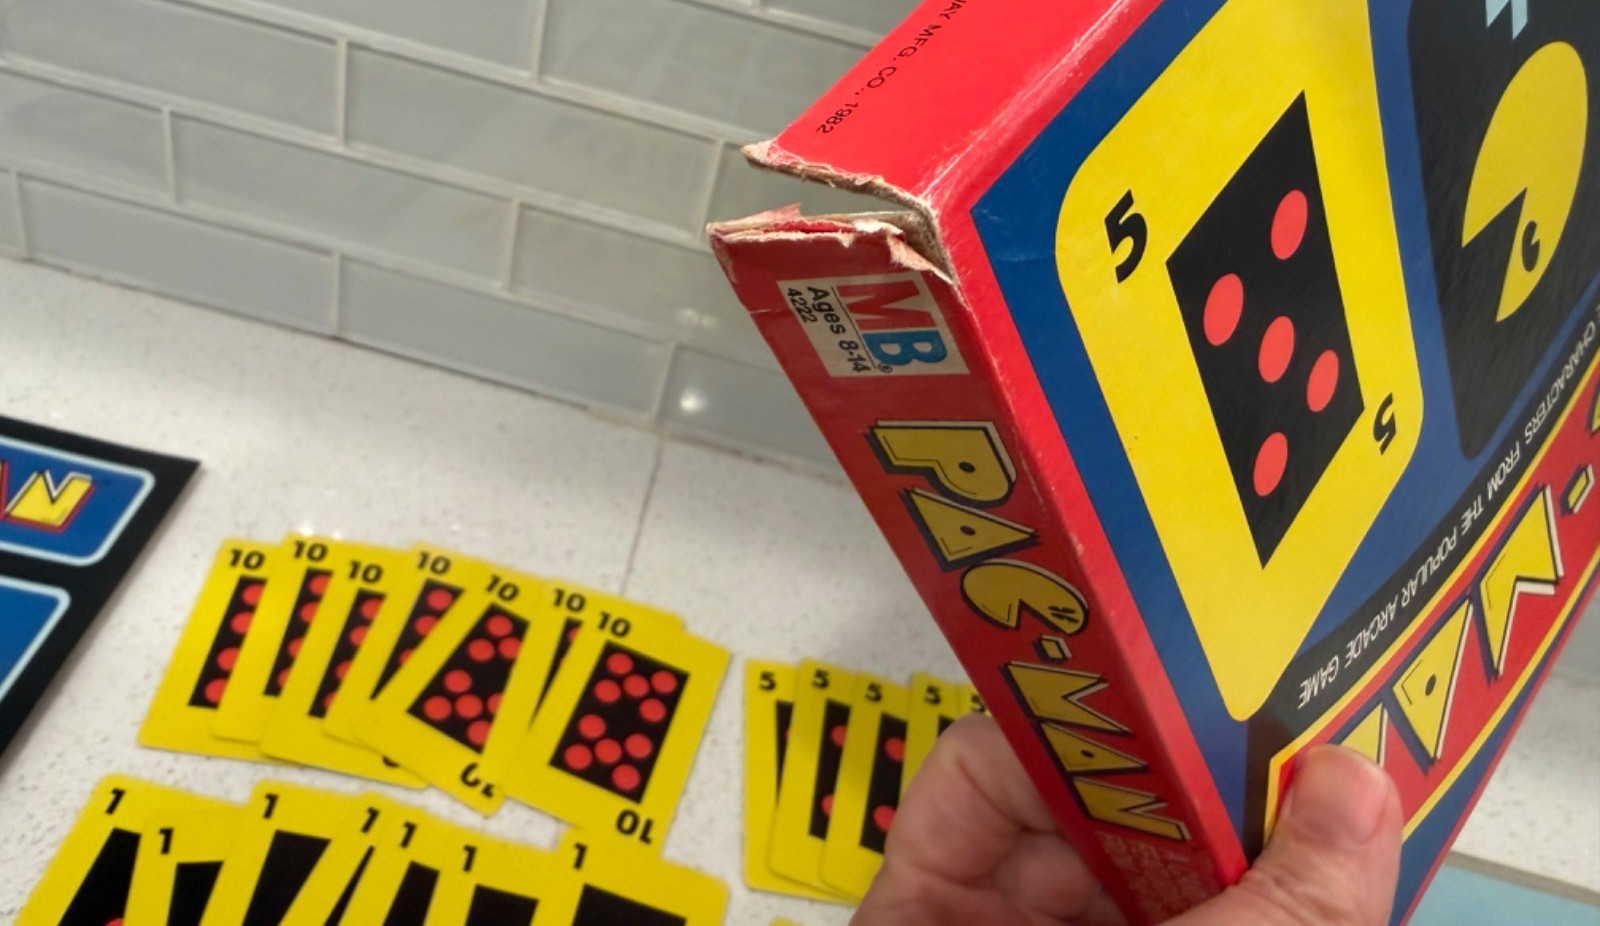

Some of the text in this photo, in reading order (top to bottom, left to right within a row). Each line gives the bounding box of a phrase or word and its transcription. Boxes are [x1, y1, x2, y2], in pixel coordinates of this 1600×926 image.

[941, 0, 966, 19] AY
[893, 24, 941, 61] MFG.
[816, 102, 858, 134] 1982
[1104, 189, 1148, 284] 5
[787, 287, 817, 323] 4222
[807, 286, 872, 373] Ages 8-14
[1373, 392, 1396, 456] 5
[1298, 321, 1595, 710] CHARACTERS FROM THE POPULAR ARCADE GAME
[229, 548, 264, 570] 10
[293, 540, 328, 562] 10
[416, 551, 451, 575] 10
[348, 561, 382, 583] 10
[485, 574, 519, 602] 10
[552, 588, 586, 612] 10
[596, 611, 631, 638] 10
[866, 419, 1191, 842] PAC-MAN
[759, 671, 776, 691] 5
[812, 669, 830, 689] 5
[865, 683, 882, 703] 5
[924, 685, 941, 705] 5
[105, 788, 125, 814] 1
[262, 794, 279, 820] 1
[361, 807, 380, 834] 1
[615, 809, 654, 845] 10
[158, 828, 174, 855] 1
[400, 822, 417, 849] 1
[462, 844, 478, 873] 1
[572, 843, 588, 871] 1
